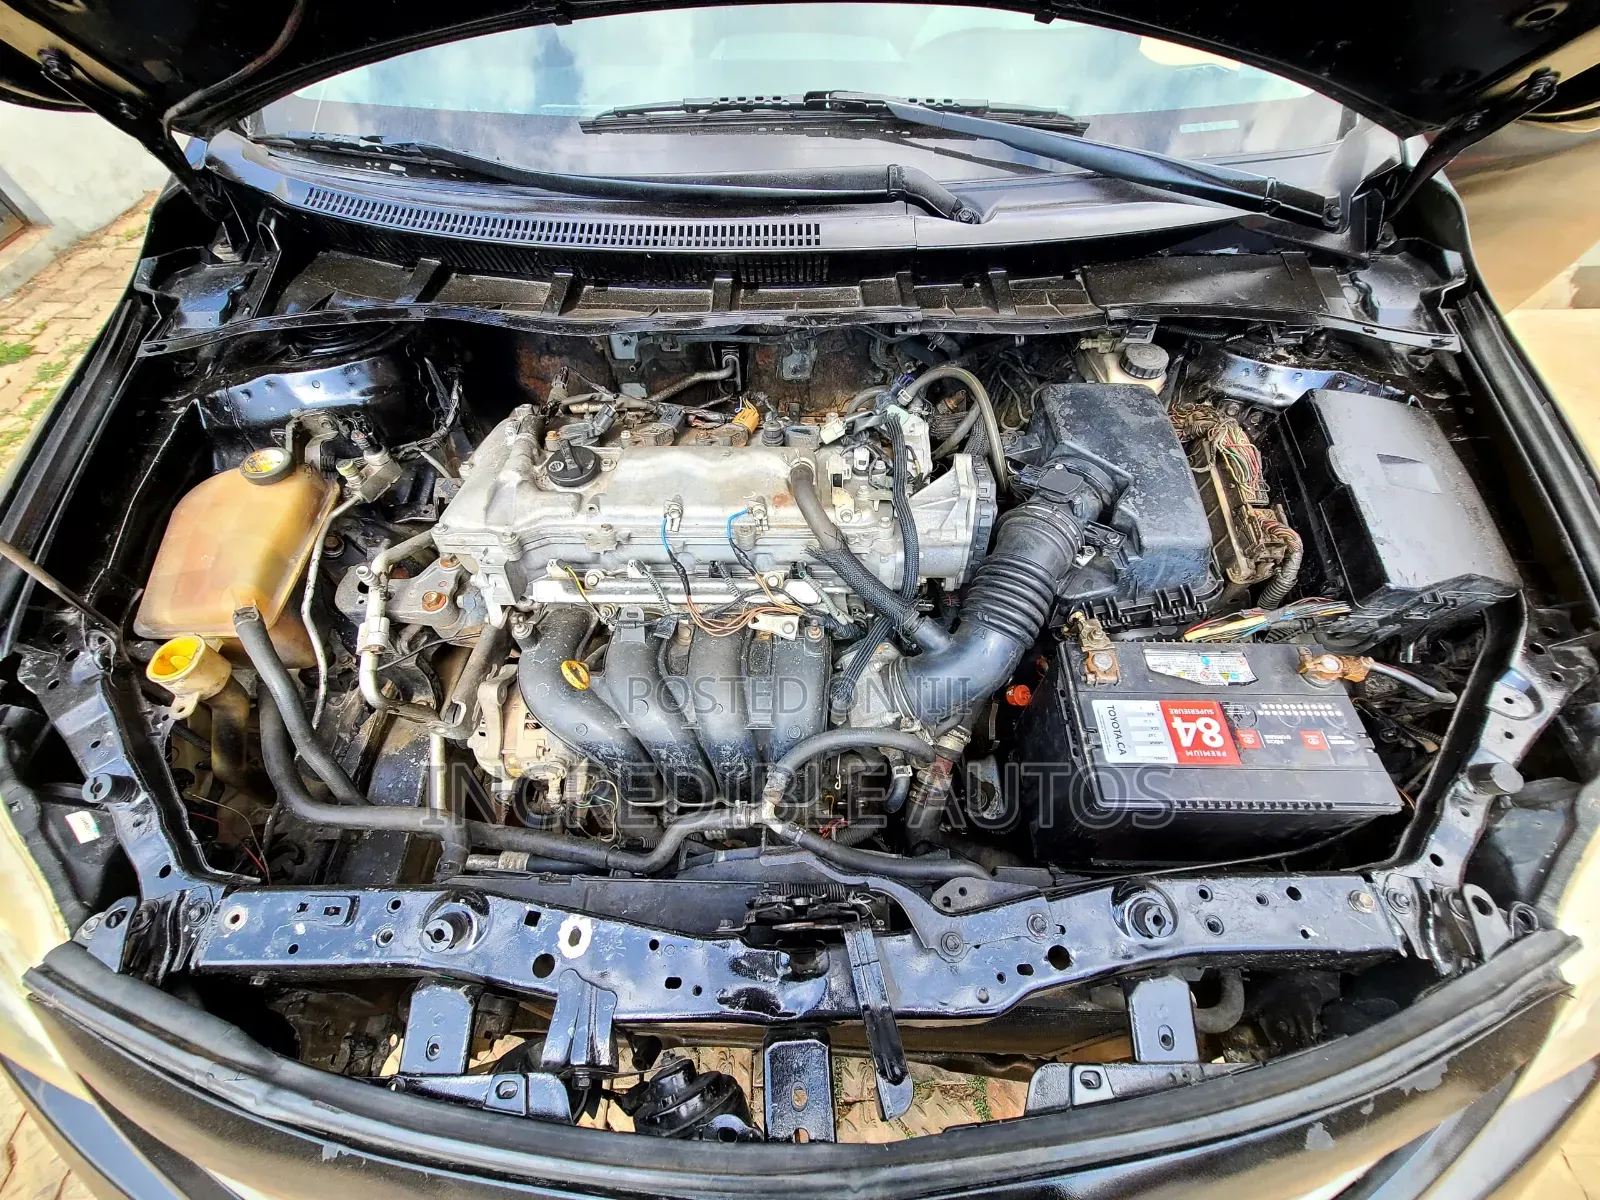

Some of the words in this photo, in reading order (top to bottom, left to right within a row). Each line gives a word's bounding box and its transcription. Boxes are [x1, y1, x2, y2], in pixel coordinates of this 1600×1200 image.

[1106, 704, 1127, 756] TOYOTA.CA
[1171, 716, 1225, 749] 84
[1185, 749, 1227, 757] PREMIUM
